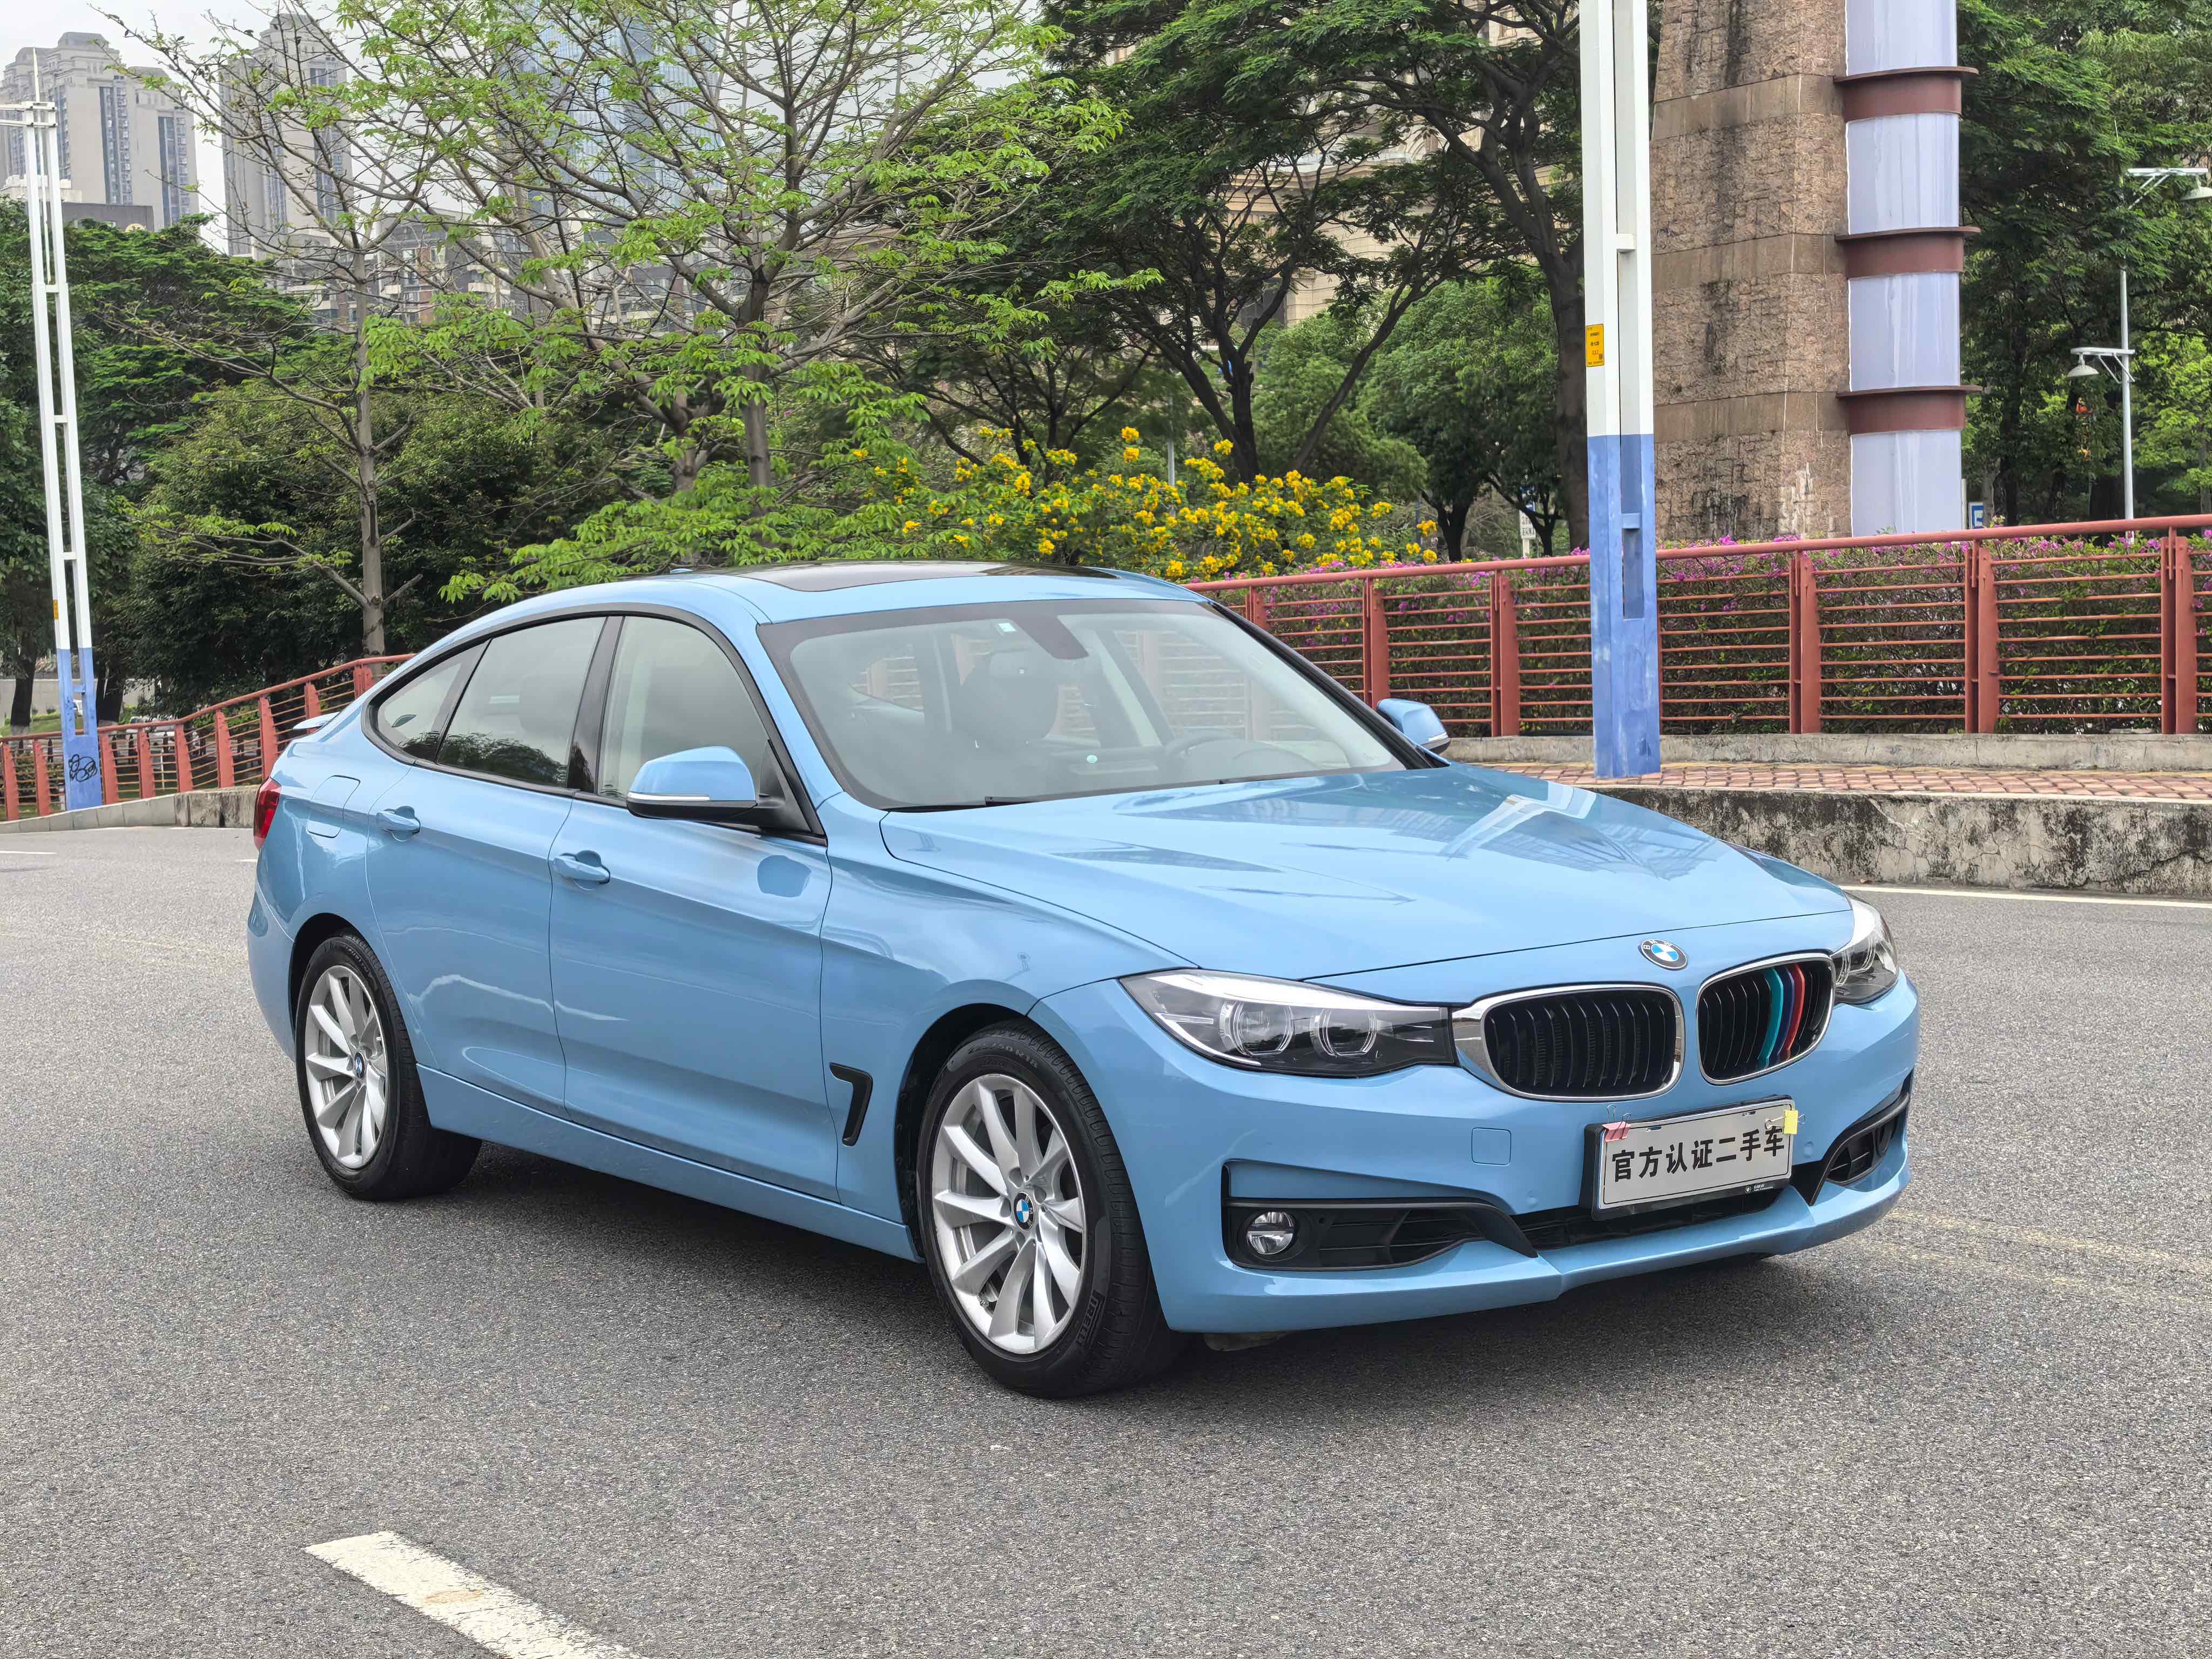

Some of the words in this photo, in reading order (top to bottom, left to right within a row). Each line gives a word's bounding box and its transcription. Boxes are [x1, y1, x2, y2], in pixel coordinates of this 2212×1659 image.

[1612, 1125, 1784, 1182] 官方认证二手车
